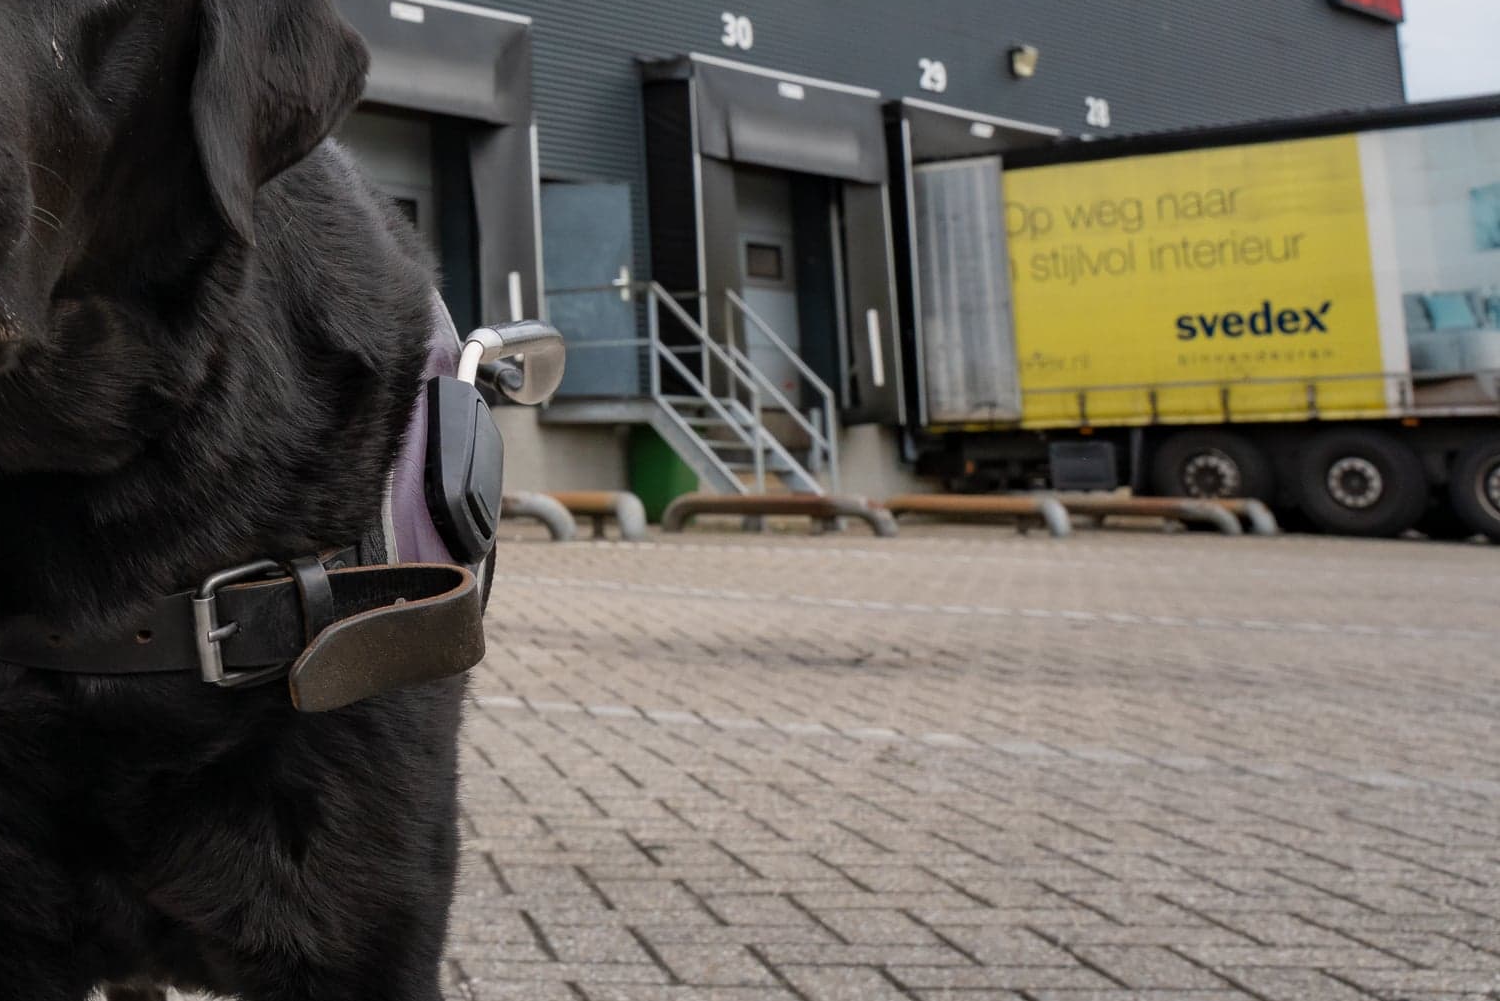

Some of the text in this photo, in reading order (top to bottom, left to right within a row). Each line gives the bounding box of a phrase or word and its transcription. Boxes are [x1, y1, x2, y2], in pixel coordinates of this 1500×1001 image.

[721, 11, 754, 50] 30
[918, 57, 948, 93] 29
[1006, 187, 1241, 240] Op weg naar
[1031, 240, 1137, 285] stijlvol
[1148, 231, 1305, 273] interieur
[1175, 299, 1332, 341] svedex
